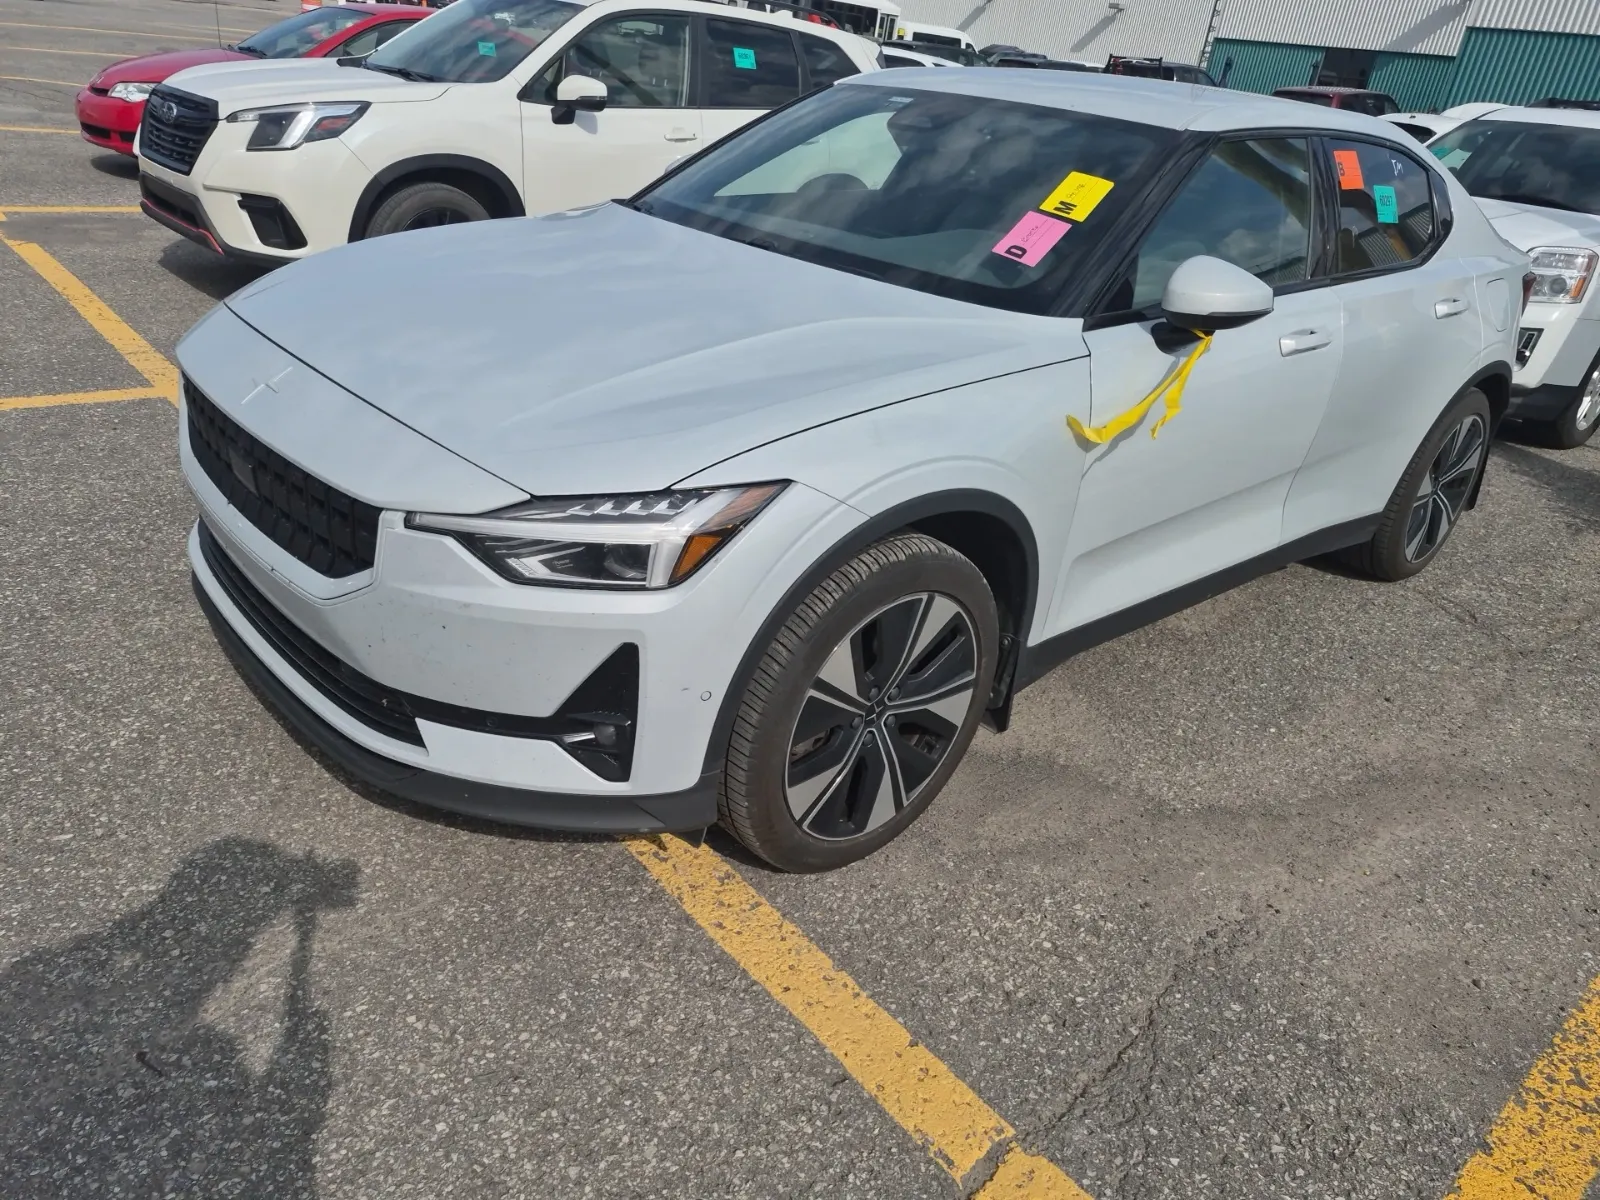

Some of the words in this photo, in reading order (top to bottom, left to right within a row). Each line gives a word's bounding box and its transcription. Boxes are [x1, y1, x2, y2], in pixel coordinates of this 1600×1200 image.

[1337, 162, 1345, 176] B
[1053, 200, 1078, 215] M
[1004, 244, 1027, 260] D
